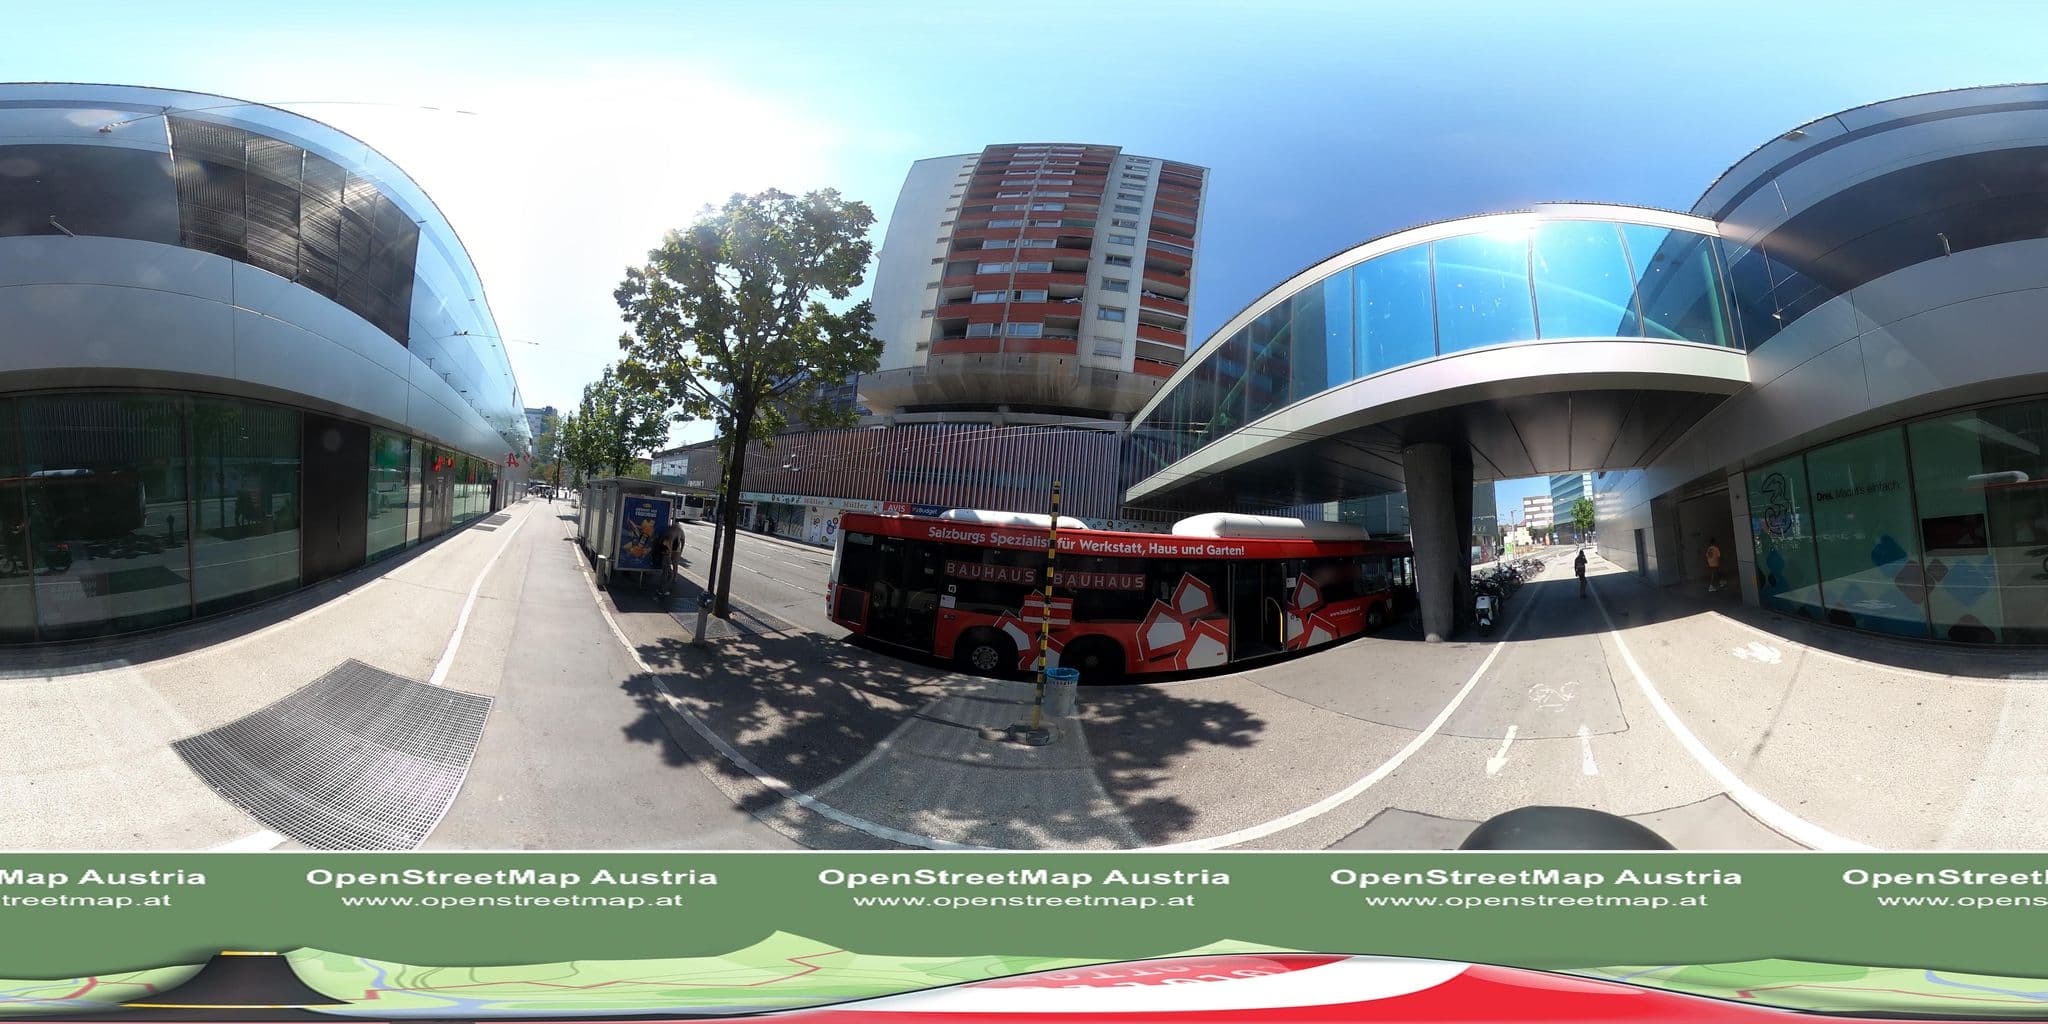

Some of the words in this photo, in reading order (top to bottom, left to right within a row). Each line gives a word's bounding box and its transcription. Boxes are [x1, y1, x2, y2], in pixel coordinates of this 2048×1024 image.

[888, 505, 906, 513] AVIS
[928, 526, 986, 544] Salzburgs
[990, 532, 1050, 548] Spezialist
[1057, 538, 1076, 550] für
[1079, 539, 1146, 557] Werkstatt,
[1149, 543, 1178, 555] Haus
[1181, 545, 1204, 555] und
[1206, 546, 1245, 556] Garten!
[946, 562, 1036, 582] BAUHAUS
[1053, 573, 1145, 589] BAUHAUS
